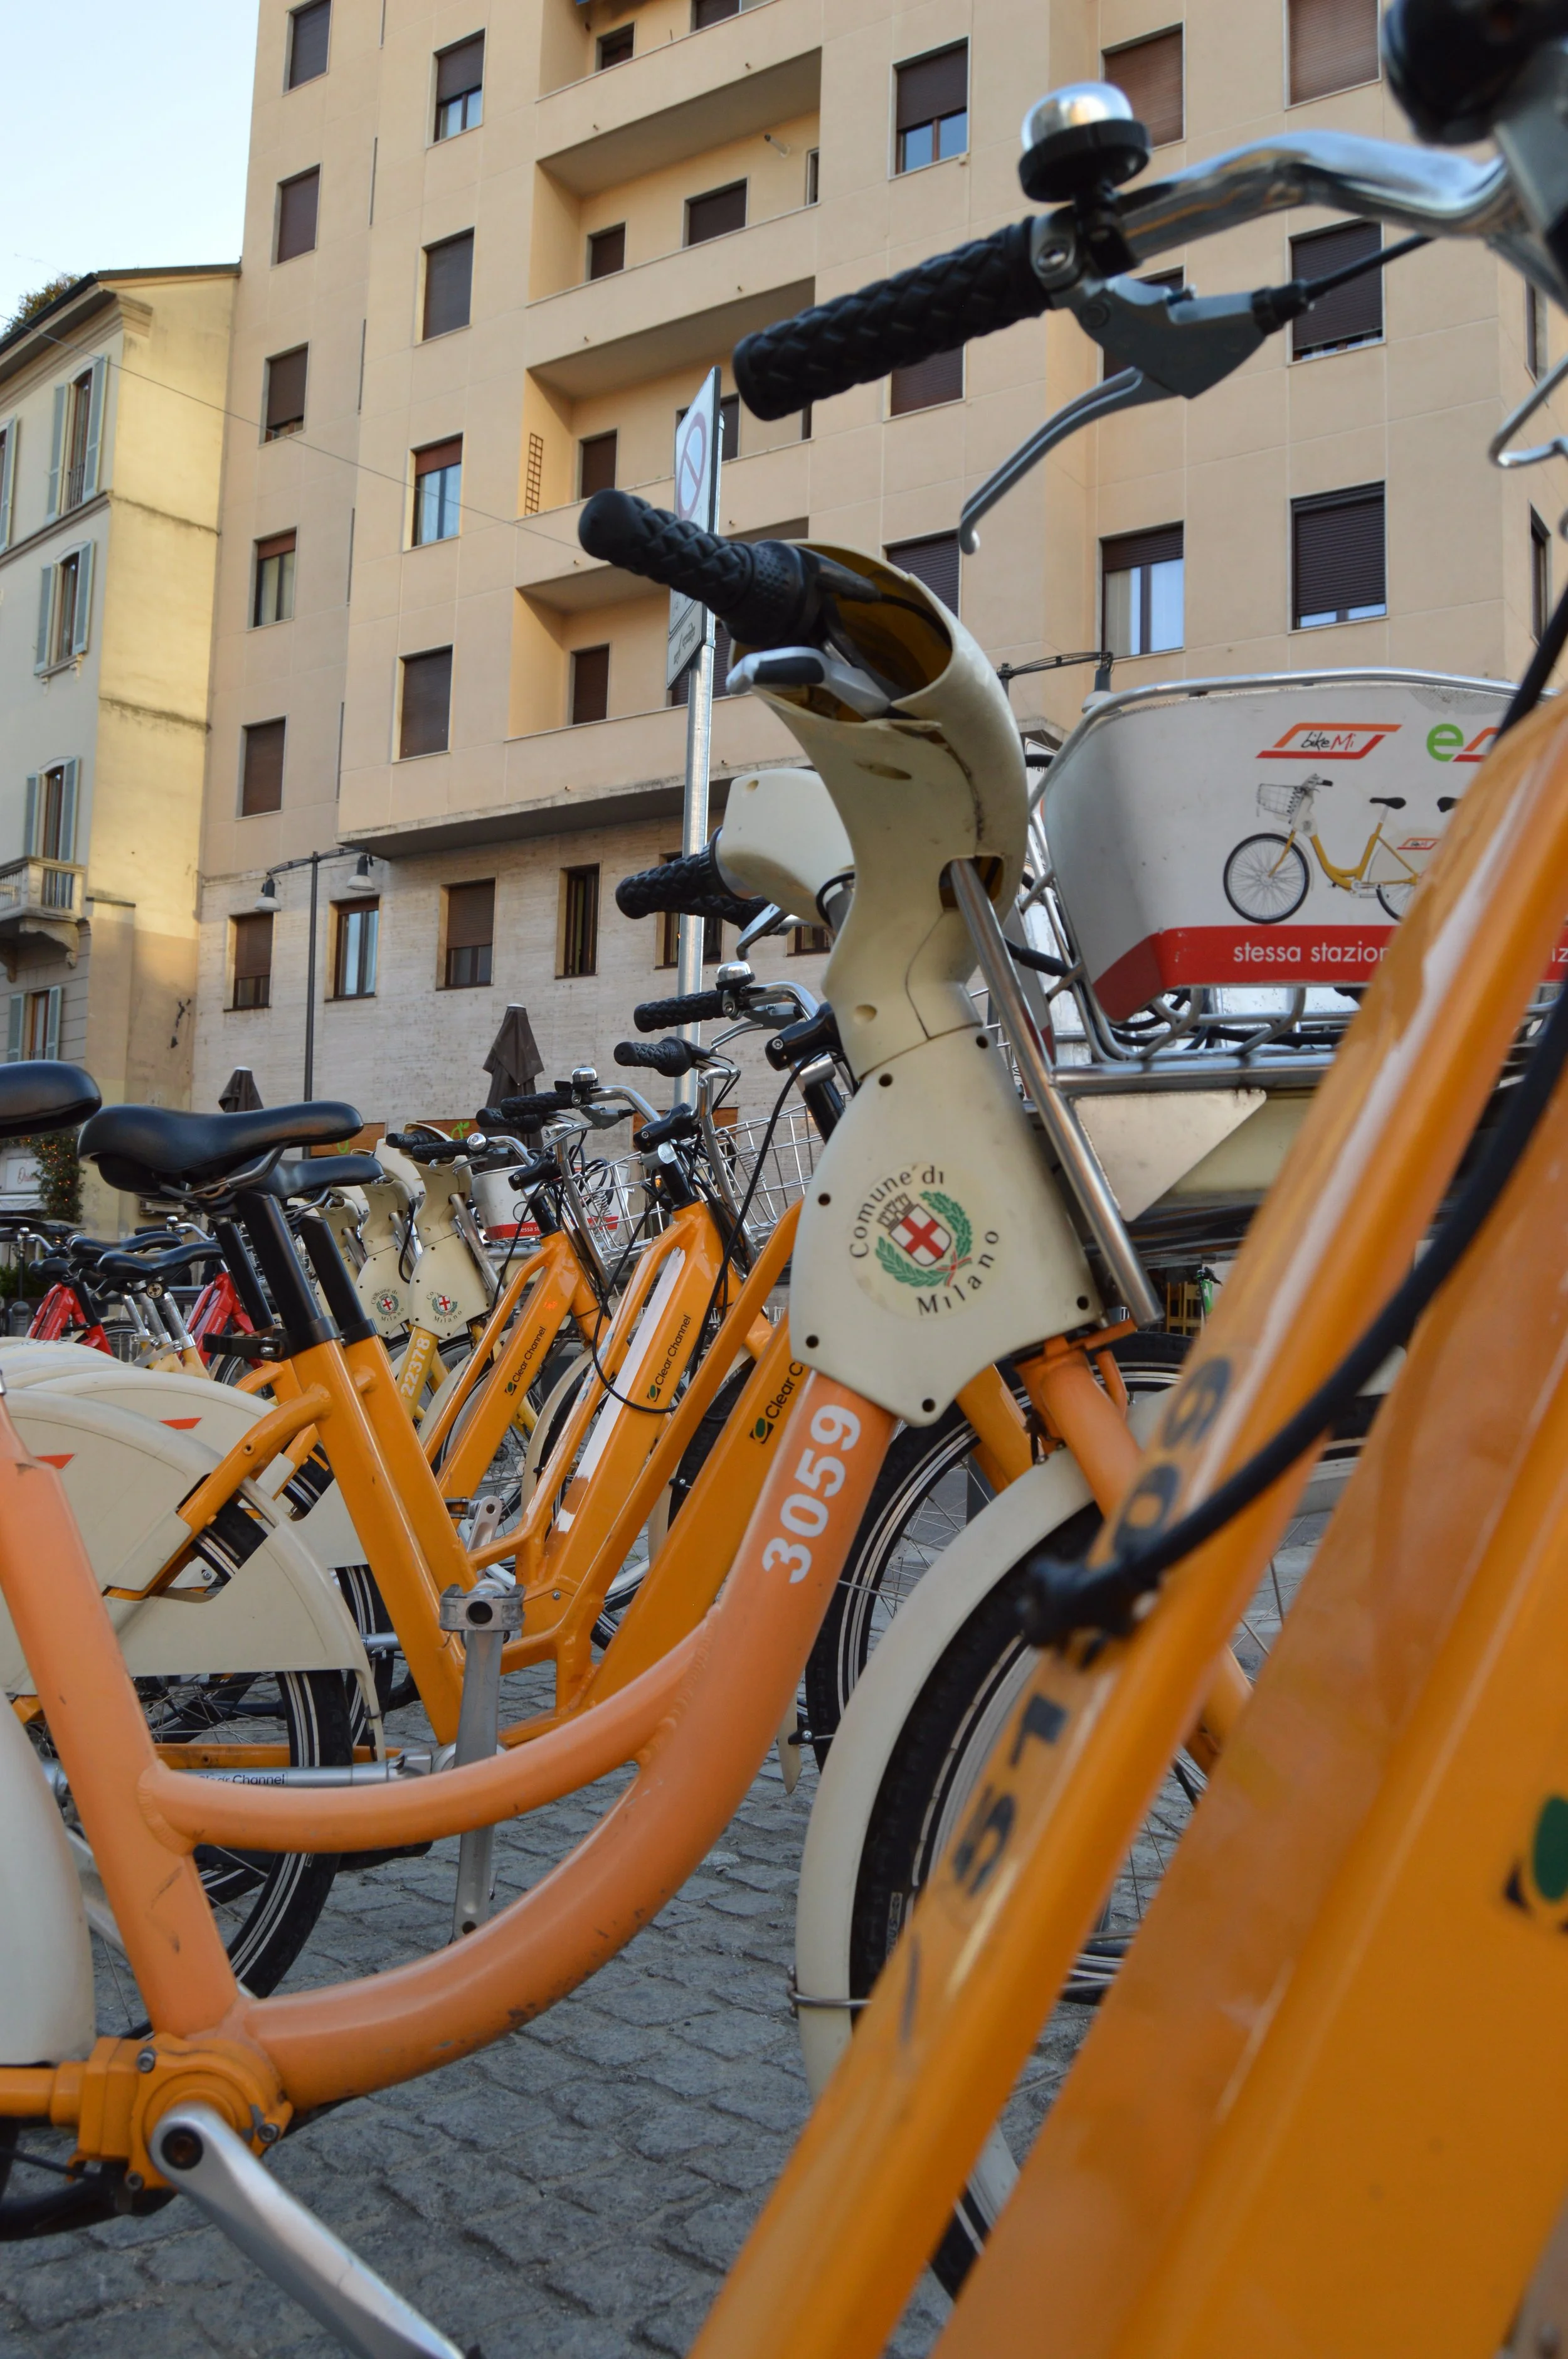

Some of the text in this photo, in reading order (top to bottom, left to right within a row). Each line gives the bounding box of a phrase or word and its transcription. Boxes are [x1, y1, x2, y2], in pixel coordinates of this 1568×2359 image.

[1233, 942, 1301, 962] stessa
[849, 1165, 944, 1259] Comune di
[916, 1230, 1000, 1316] Milano
[381, 1307, 405, 1322] Milano
[433, 1310, 462, 1323] Milano
[401, 1338, 431, 1397] 22378
[512, 1325, 546, 1383] Clear Channel
[655, 1314, 692, 1386] Clear Channel
[765, 1377, 795, 1419] Clear
[761, 1404, 861, 1584] 3059
[952, 1356, 1233, 1897] 5109
[232, 1774, 285, 1785] Channel
